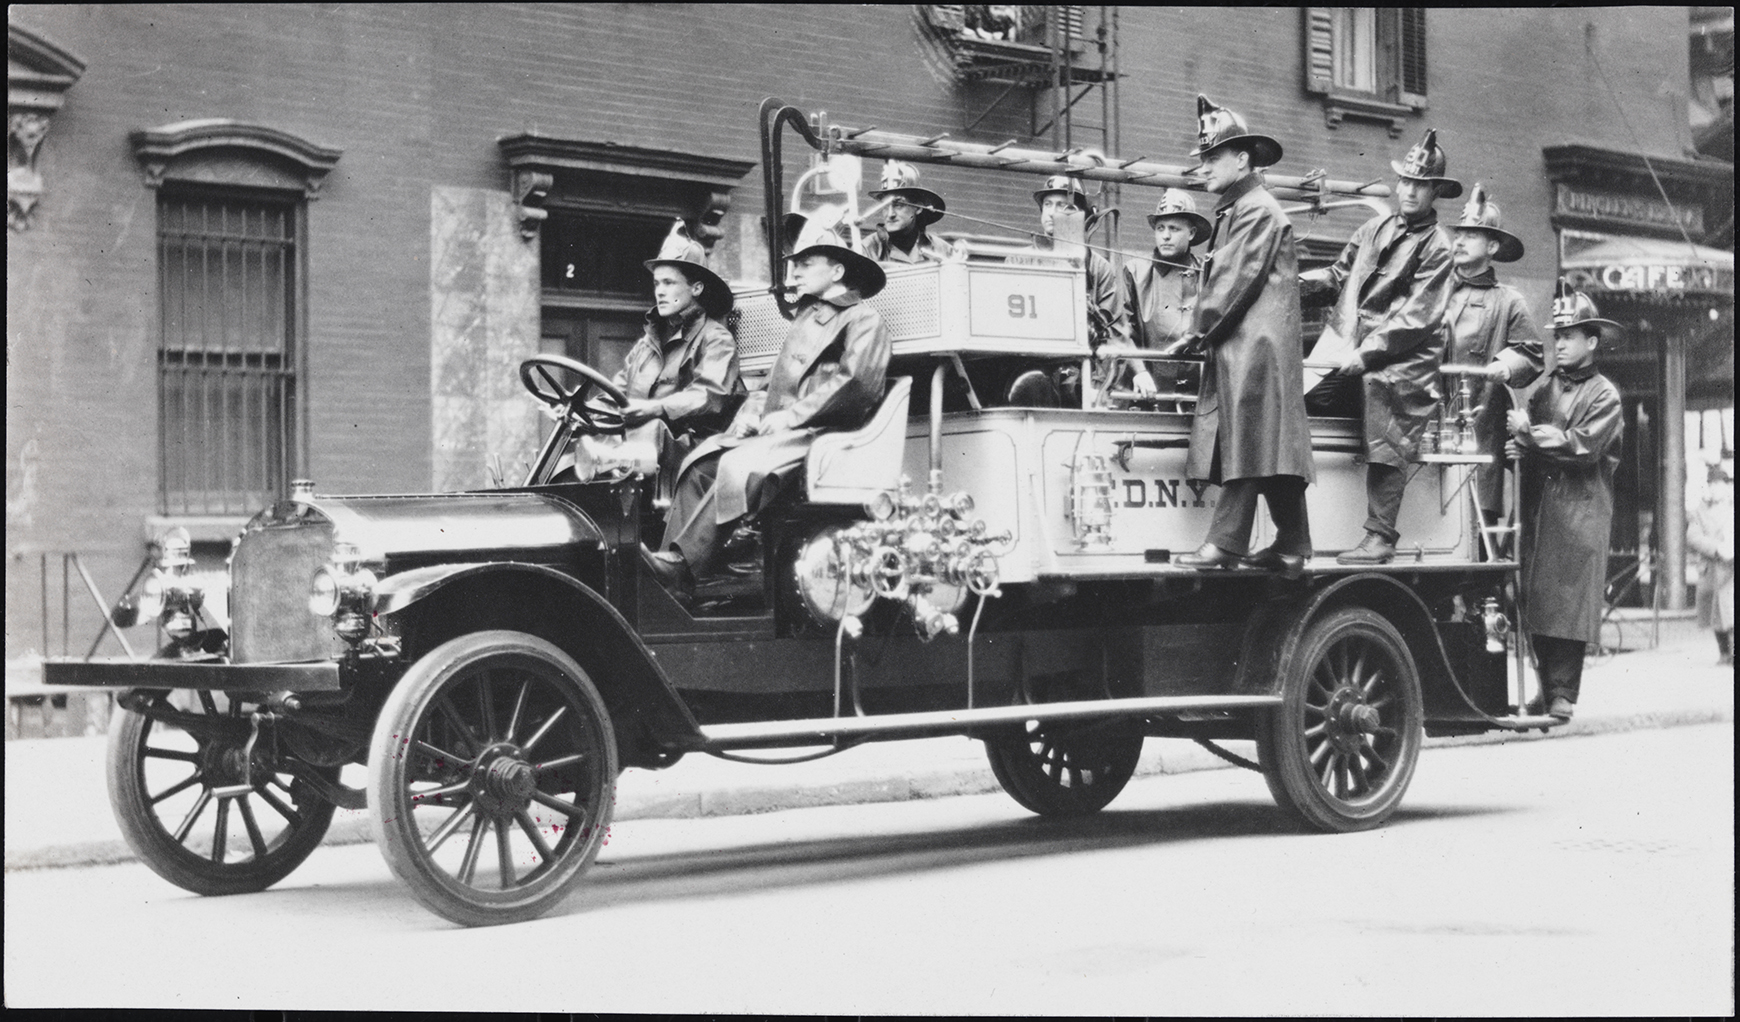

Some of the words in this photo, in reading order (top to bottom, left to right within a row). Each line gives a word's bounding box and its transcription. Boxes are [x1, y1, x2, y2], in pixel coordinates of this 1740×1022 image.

[565, 263, 575, 278] 2
[1602, 265, 1685, 291] CAFE
[1007, 293, 1038, 319] 91
[1110, 478, 1217, 508] .D.N.Y.
